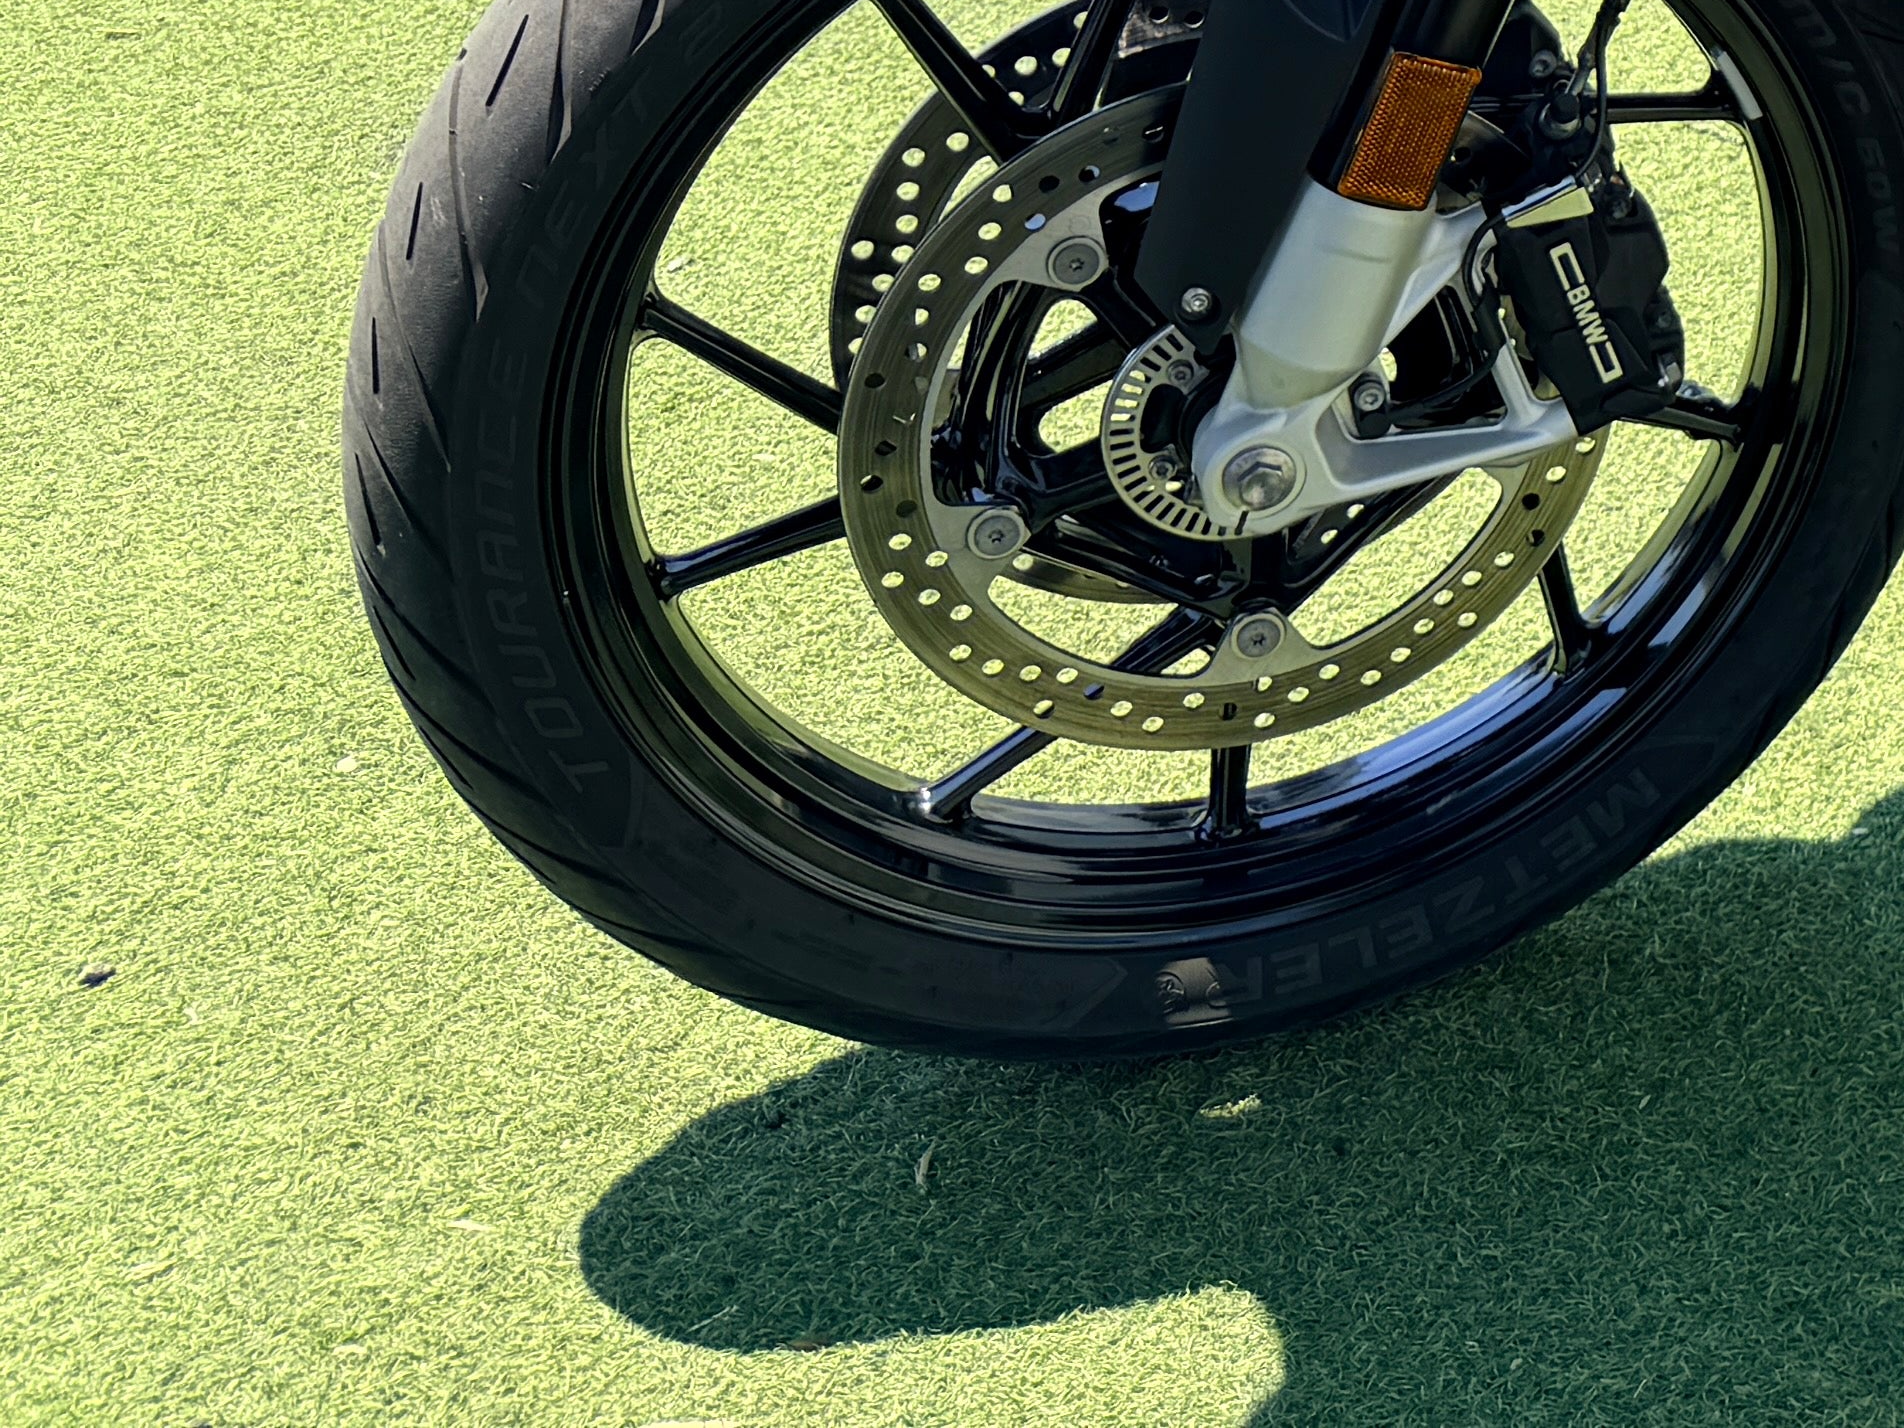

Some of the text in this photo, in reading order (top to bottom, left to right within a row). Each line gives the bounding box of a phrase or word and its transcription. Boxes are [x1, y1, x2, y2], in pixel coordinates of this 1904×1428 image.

[1566, 284, 1610, 346] BMW
[474, 337, 611, 794] TOURANCE
[1207, 765, 1663, 1005] METZELER
